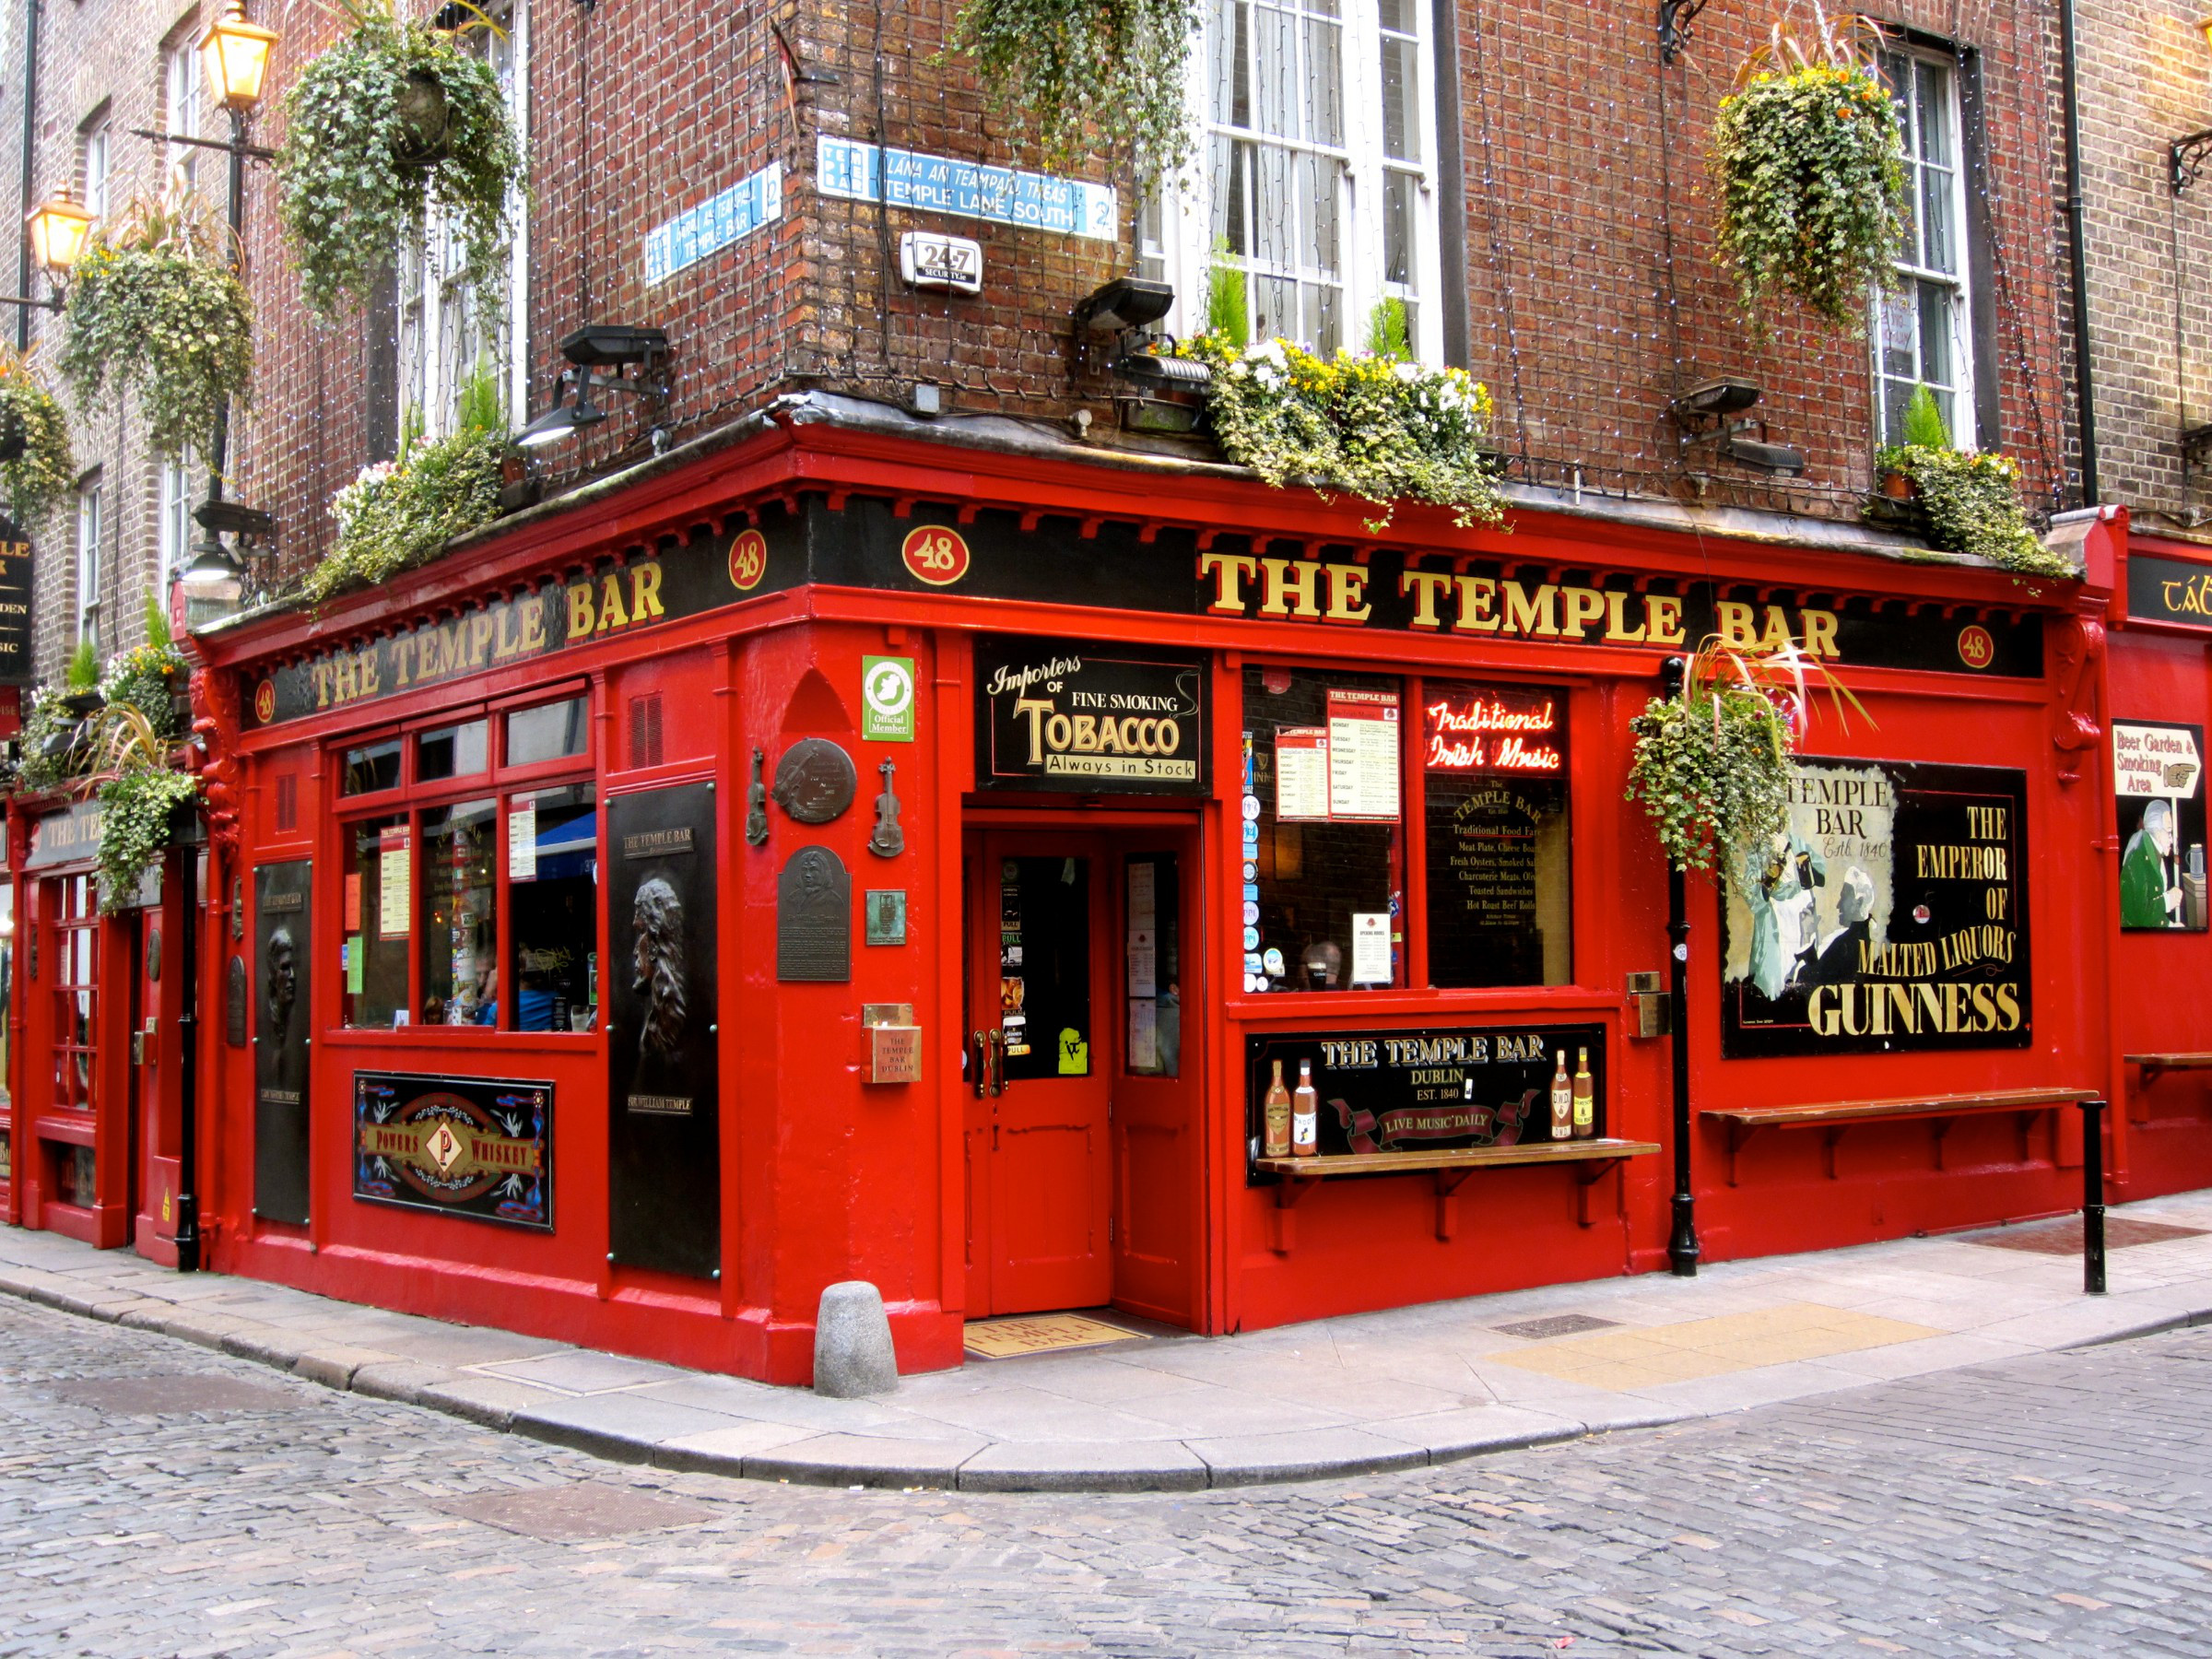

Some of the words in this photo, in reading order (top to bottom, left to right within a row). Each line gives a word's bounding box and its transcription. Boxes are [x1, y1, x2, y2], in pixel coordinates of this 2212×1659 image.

[887, 153, 922, 180] LÁNA
[928, 165, 947, 182] AN
[1027, 182, 1068, 203] THEAS
[768, 179, 778, 207] 2
[886, 179, 953, 206] TEMPLE
[959, 191, 1008, 215] LANE
[1014, 199, 1074, 228] SOUTH
[1095, 199, 1111, 227] 2
[684, 225, 723, 259] TEMPLE
[725, 213, 747, 241] BAR
[735, 541, 760, 580] 48
[913, 533, 956, 571] 48
[1199, 552, 1373, 627] THE
[1398, 570, 1687, 647] TEMPLE
[1714, 599, 1842, 659] BAR
[312, 647, 382, 709] THE
[391, 596, 547, 689] TEMPLE
[563, 561, 665, 643] BAR
[1963, 632, 1986, 660] 48
[986, 654, 1082, 698] Importers
[1047, 681, 1064, 693] OF
[259, 689, 272, 716] 48
[1072, 691, 1107, 708] FINE
[1110, 694, 1179, 712] SMOKING
[1329, 690, 1347, 700] THE
[1347, 691, 1380, 701] TEMPLE
[872, 723, 907, 733] Member
[874, 714, 904, 724] Official
[1428, 700, 1554, 732] Traditional
[1012, 697, 1181, 766] TOBACCO
[2116, 730, 2141, 751] Beer
[2144, 733, 2183, 754] Garden
[2185, 739, 2194, 755] &
[1426, 734, 1485, 768] Irish
[1494, 736, 1560, 770] Music
[2116, 751, 2162, 777] Smoking
[1049, 756, 1112, 774] Always
[1122, 759, 1136, 774] in
[1144, 759, 1194, 778] Stock
[1490, 780, 1503, 788] The
[1785, 777, 1890, 808] TEMPLE
[2127, 773, 2153, 794] Area
[1453, 790, 1511, 822] TEMPLE
[1514, 796, 1542, 825] BAR
[49, 817, 76, 847] THE
[1453, 823, 1500, 836] Traditional
[1501, 825, 1523, 836] Food
[1815, 808, 1867, 840] BAR
[1966, 806, 2007, 841] THE
[624, 836, 639, 849] THE
[641, 831, 673, 847] TEMPLE
[674, 829, 691, 842] BAR
[1458, 841, 1476, 852] Meat
[1498, 843, 1521, 853] Cheese
[1858, 841, 1888, 859] 1840
[1450, 855, 1468, 866] Fresh
[1499, 857, 1524, 867] Smoked
[1916, 844, 2008, 881] EMPEROR
[1458, 870, 1499, 882] Charcuterie
[1468, 885, 1494, 896] Toasted
[1496, 885, 1534, 897] Sandwiches
[1985, 887, 2008, 921] OF
[1466, 900, 1480, 911] Hot
[1482, 900, 1500, 911] Roast
[1502, 900, 1517, 911] Beef
[1519, 900, 1536, 911] Rolls
[1002, 935, 1021, 943] PULL
[1857, 938, 1937, 978] MALTED
[1940, 924, 2017, 971] LIQUORS
[1807, 982, 2021, 1037] GUINNESS
[1321, 1040, 1379, 1070] THE
[1383, 1035, 1489, 1068] TEMPLE
[1495, 1033, 1548, 1064] BAR
[881, 1065, 914, 1073] DUBLIN
[1410, 1068, 1465, 1086] DUBLIN
[665, 1099, 691, 1111] TEMPLE
[1416, 1088, 1438, 1101] EST.
[1440, 1088, 1459, 1100] 1840
[1293, 1114, 1316, 1125] PADDY
[1384, 1116, 1414, 1134] LIVE
[1416, 1116, 1450, 1130] MUSIC
[1453, 1114, 1489, 1127] DAILY
[376, 1129, 419, 1154] POWERS
[439, 1129, 453, 1167] P
[471, 1138, 528, 1167] WHISKEY
